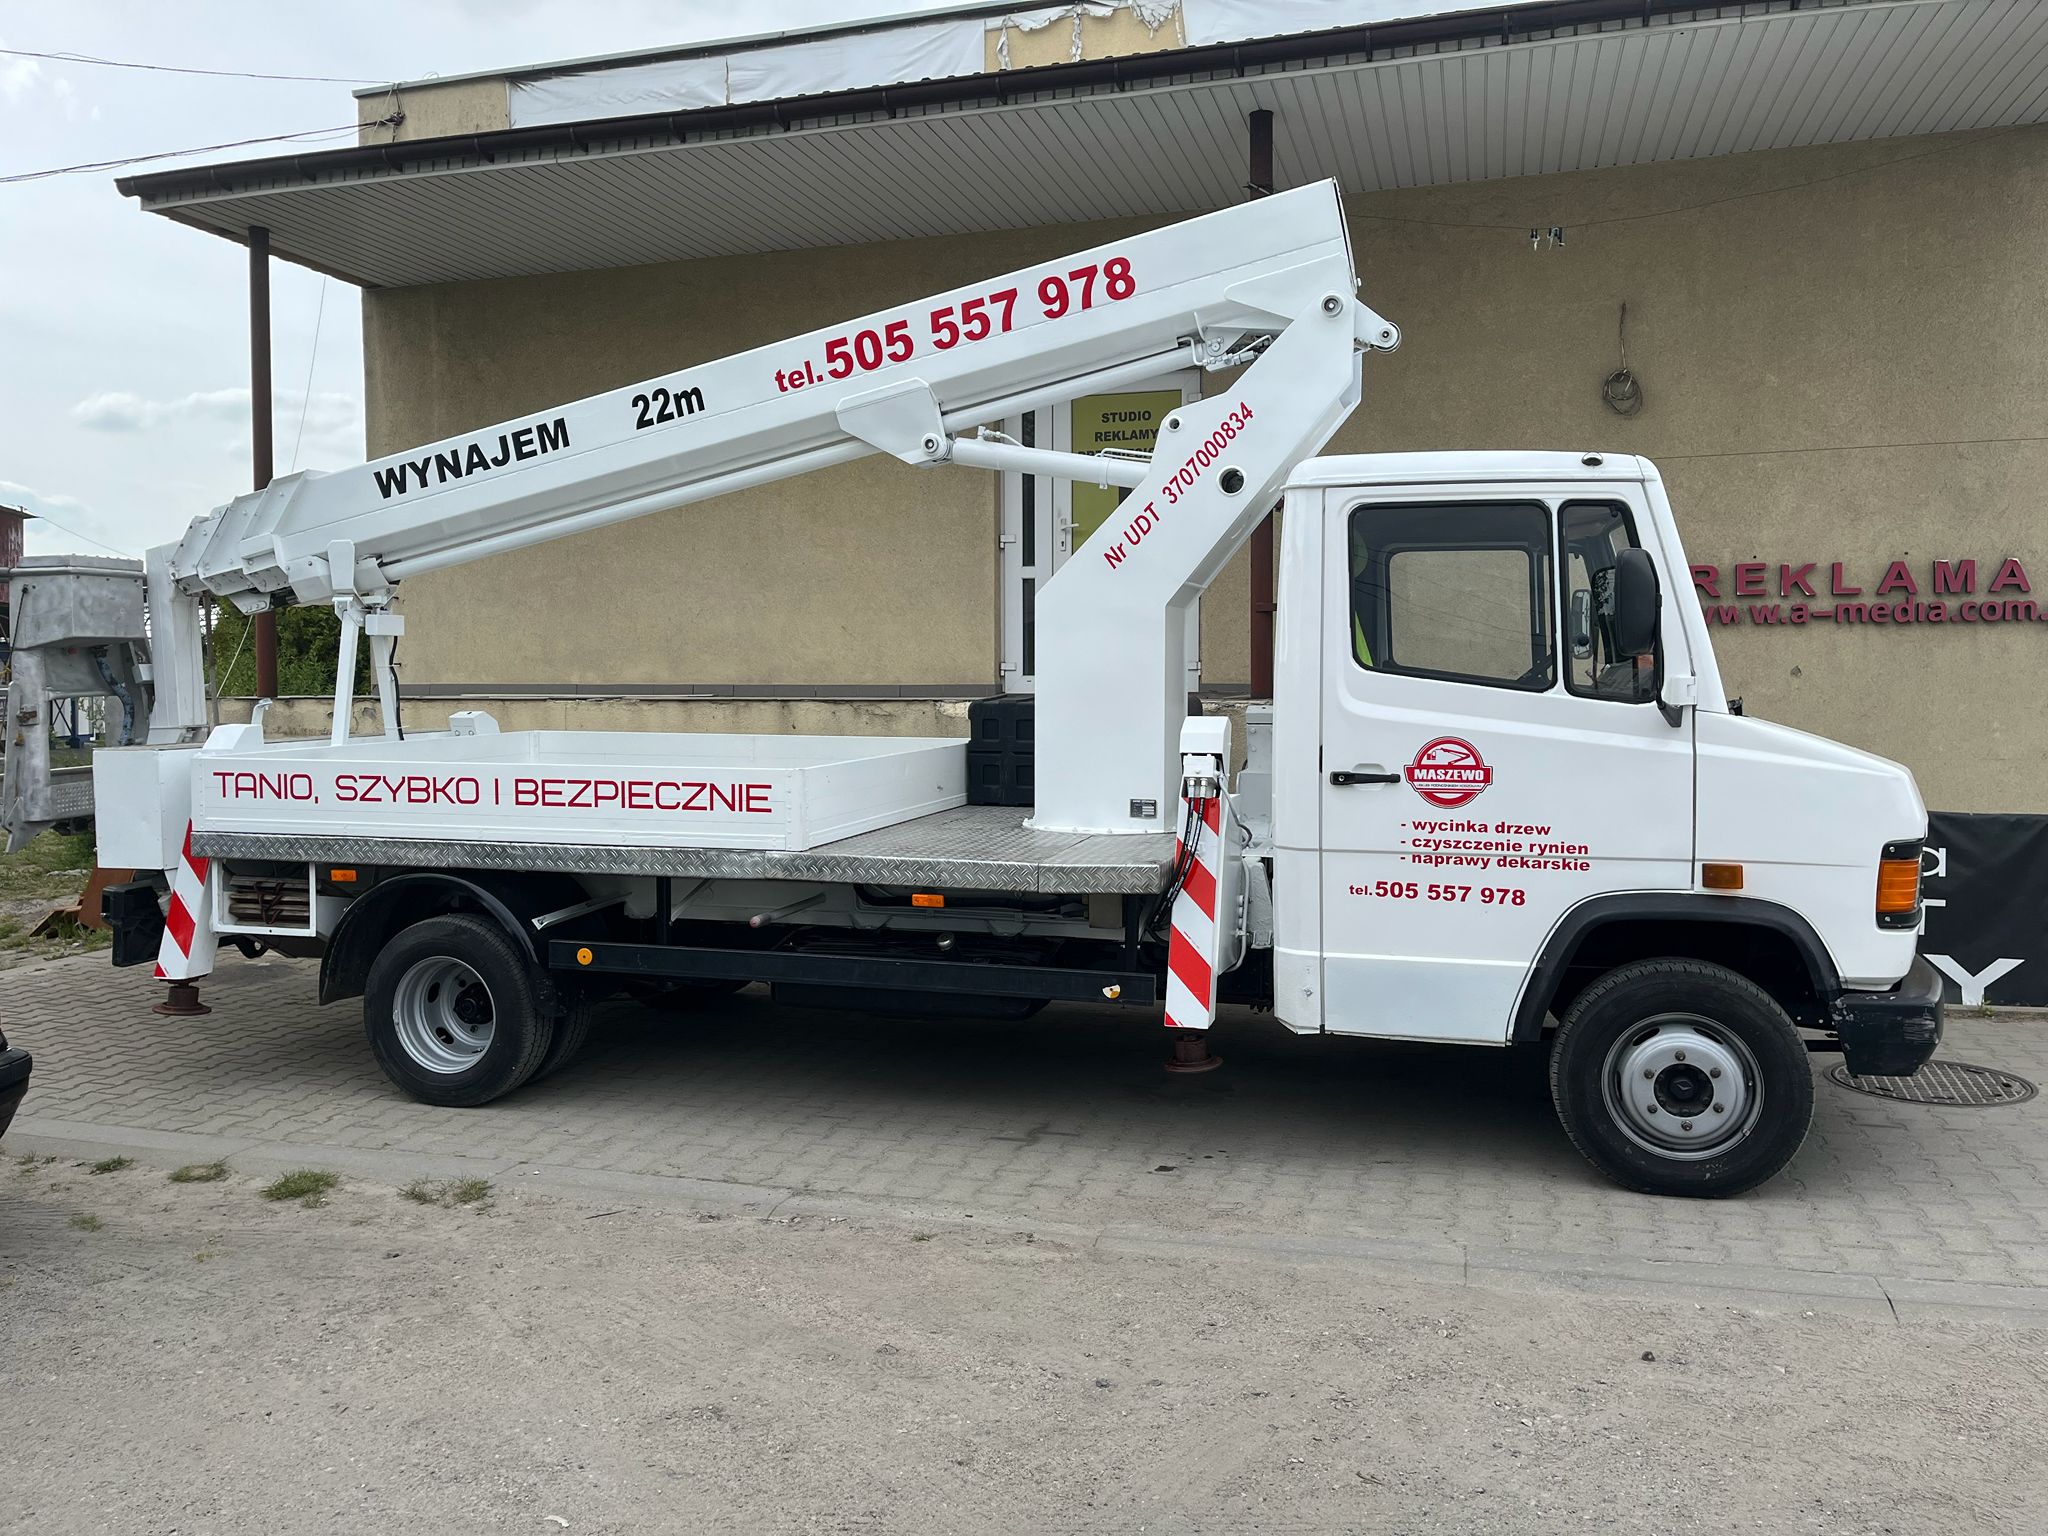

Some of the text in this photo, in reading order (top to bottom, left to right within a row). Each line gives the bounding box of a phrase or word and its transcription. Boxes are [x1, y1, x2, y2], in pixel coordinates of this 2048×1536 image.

[373, 417, 571, 500] WYNAJEM
[631, 386, 706, 431] 22m
[930, 287, 1018, 350] 557
[1037, 256, 1137, 320] 978
[1101, 410, 1152, 423] STUDIO
[1094, 428, 1160, 442] REKLAMY
[1103, 401, 1255, 570] Nr UDT 3707000834
[1690, 558, 2032, 598] REKLAMA
[1413, 768, 1485, 781] MASZEWO
[212, 771, 773, 814] TANIO, SZYBKO I BEZPIECZNIE
[1412, 820, 1489, 834] wycinka
[1494, 822, 1552, 836] drzew
[1411, 837, 1523, 853] czyszczenie
[1528, 842, 1590, 856] rynien
[1411, 853, 1492, 870] naprawy
[1496, 856, 1591, 872] dekarskie
[1427, 884, 1472, 902] 557
[1480, 887, 1526, 906] 978
